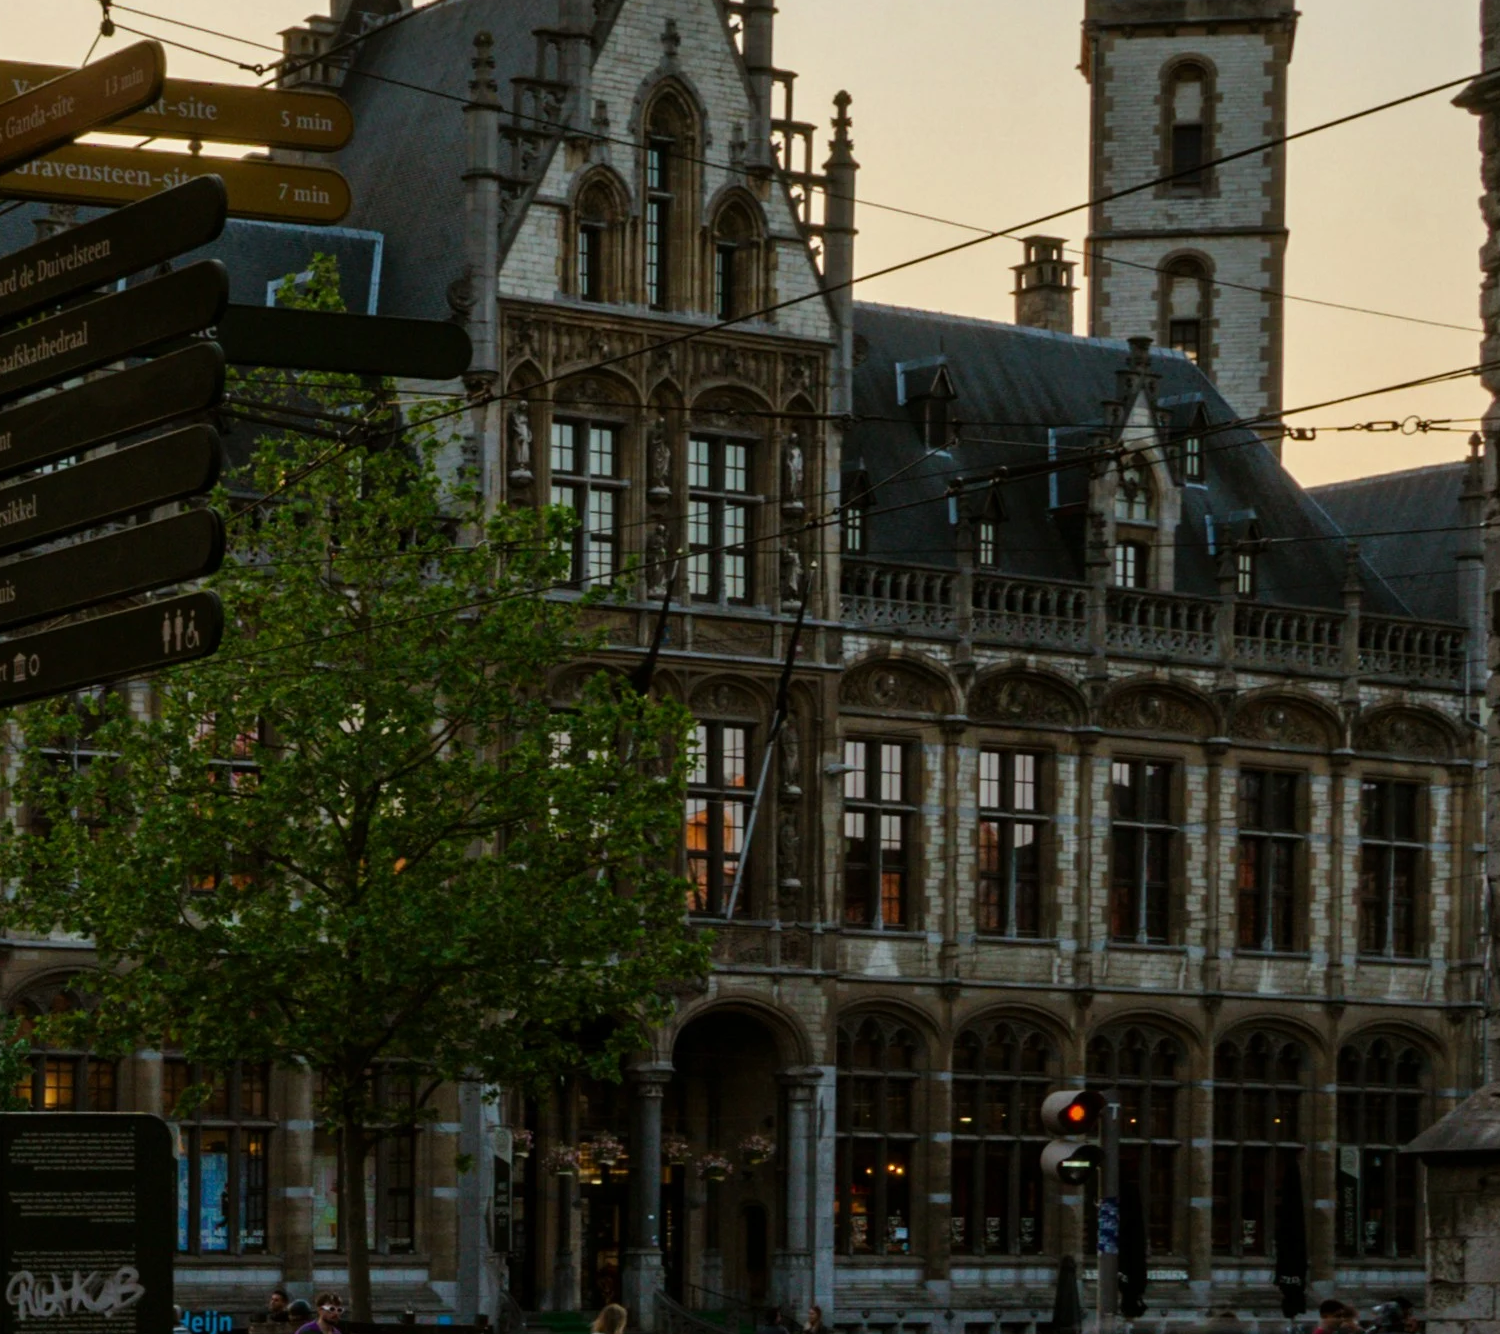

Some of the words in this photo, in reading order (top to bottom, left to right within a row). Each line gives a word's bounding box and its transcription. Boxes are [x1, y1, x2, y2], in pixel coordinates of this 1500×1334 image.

[119, 68, 145, 95] min
[5, 94, 76, 141] Ganda-site
[281, 110, 292, 128] 5
[297, 114, 333, 133] min
[278, 184, 288, 201] 7
[294, 187, 331, 205] min
[20, 265, 36, 292] de
[36, 238, 112, 280] Duivelsteen
